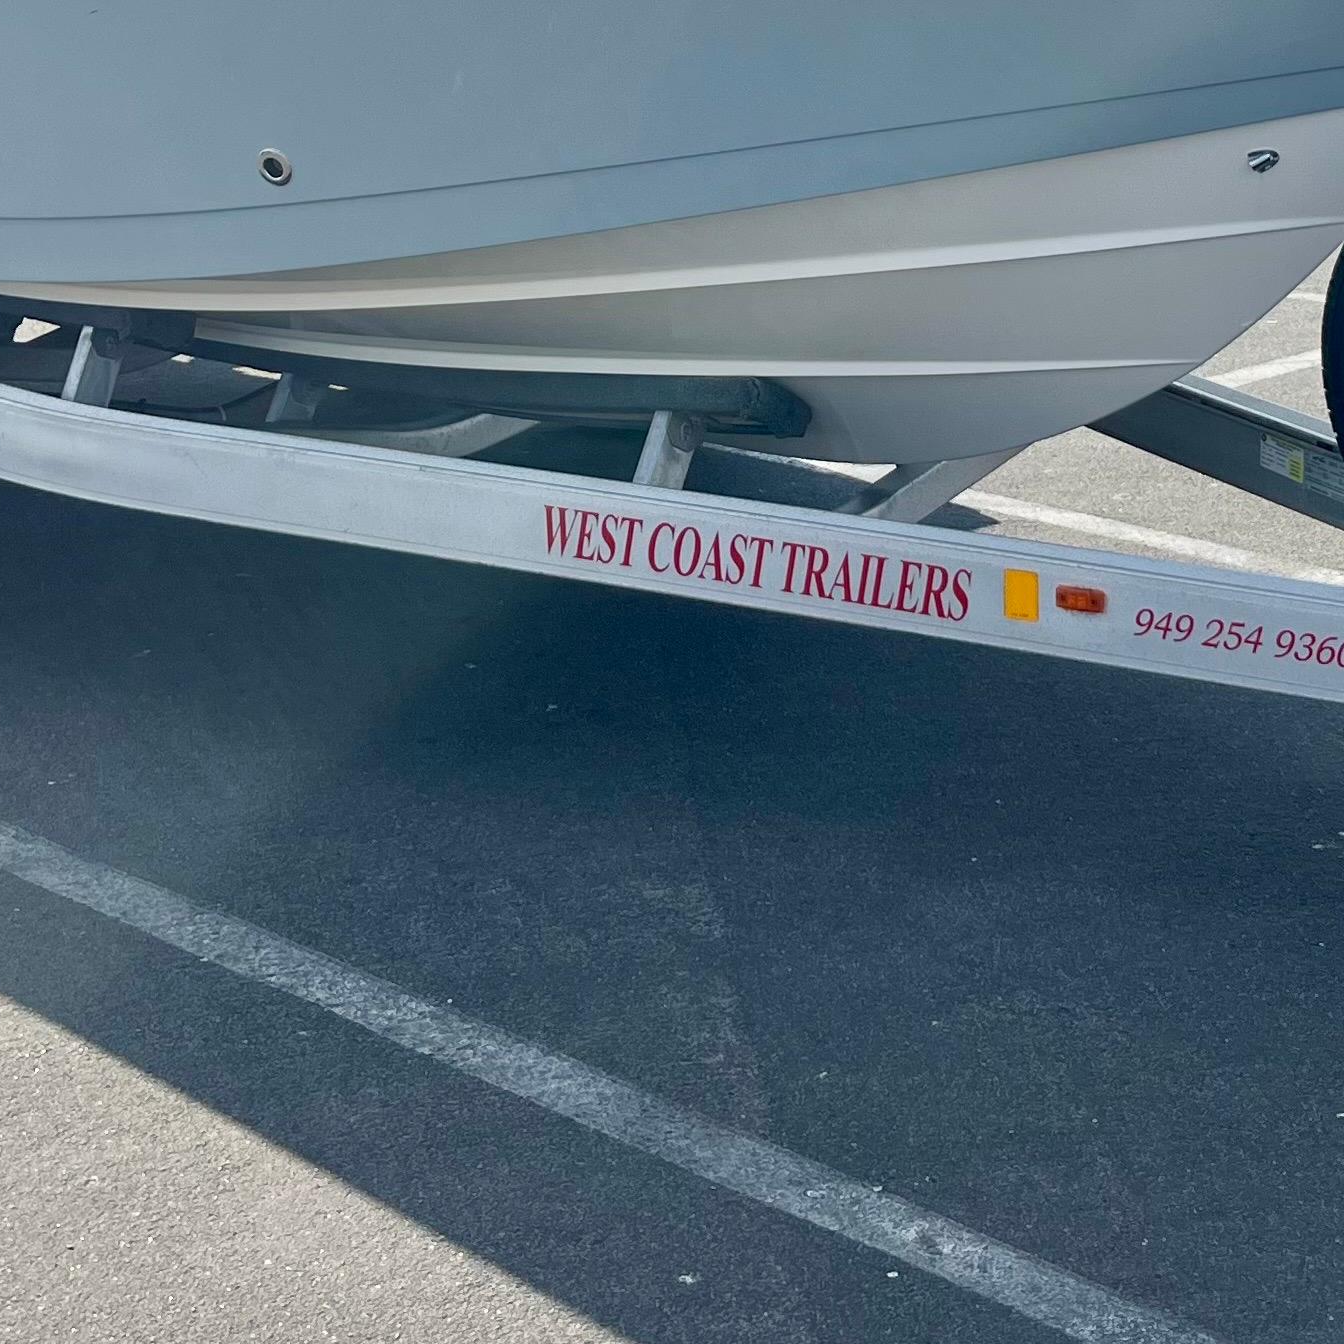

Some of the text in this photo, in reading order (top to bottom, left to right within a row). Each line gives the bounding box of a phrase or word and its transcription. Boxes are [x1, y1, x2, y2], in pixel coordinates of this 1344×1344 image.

[543, 504, 973, 622] WEST COAST TRAILERS
[1133, 608, 1195, 642] 949
[1201, 619, 1264, 654] 254
